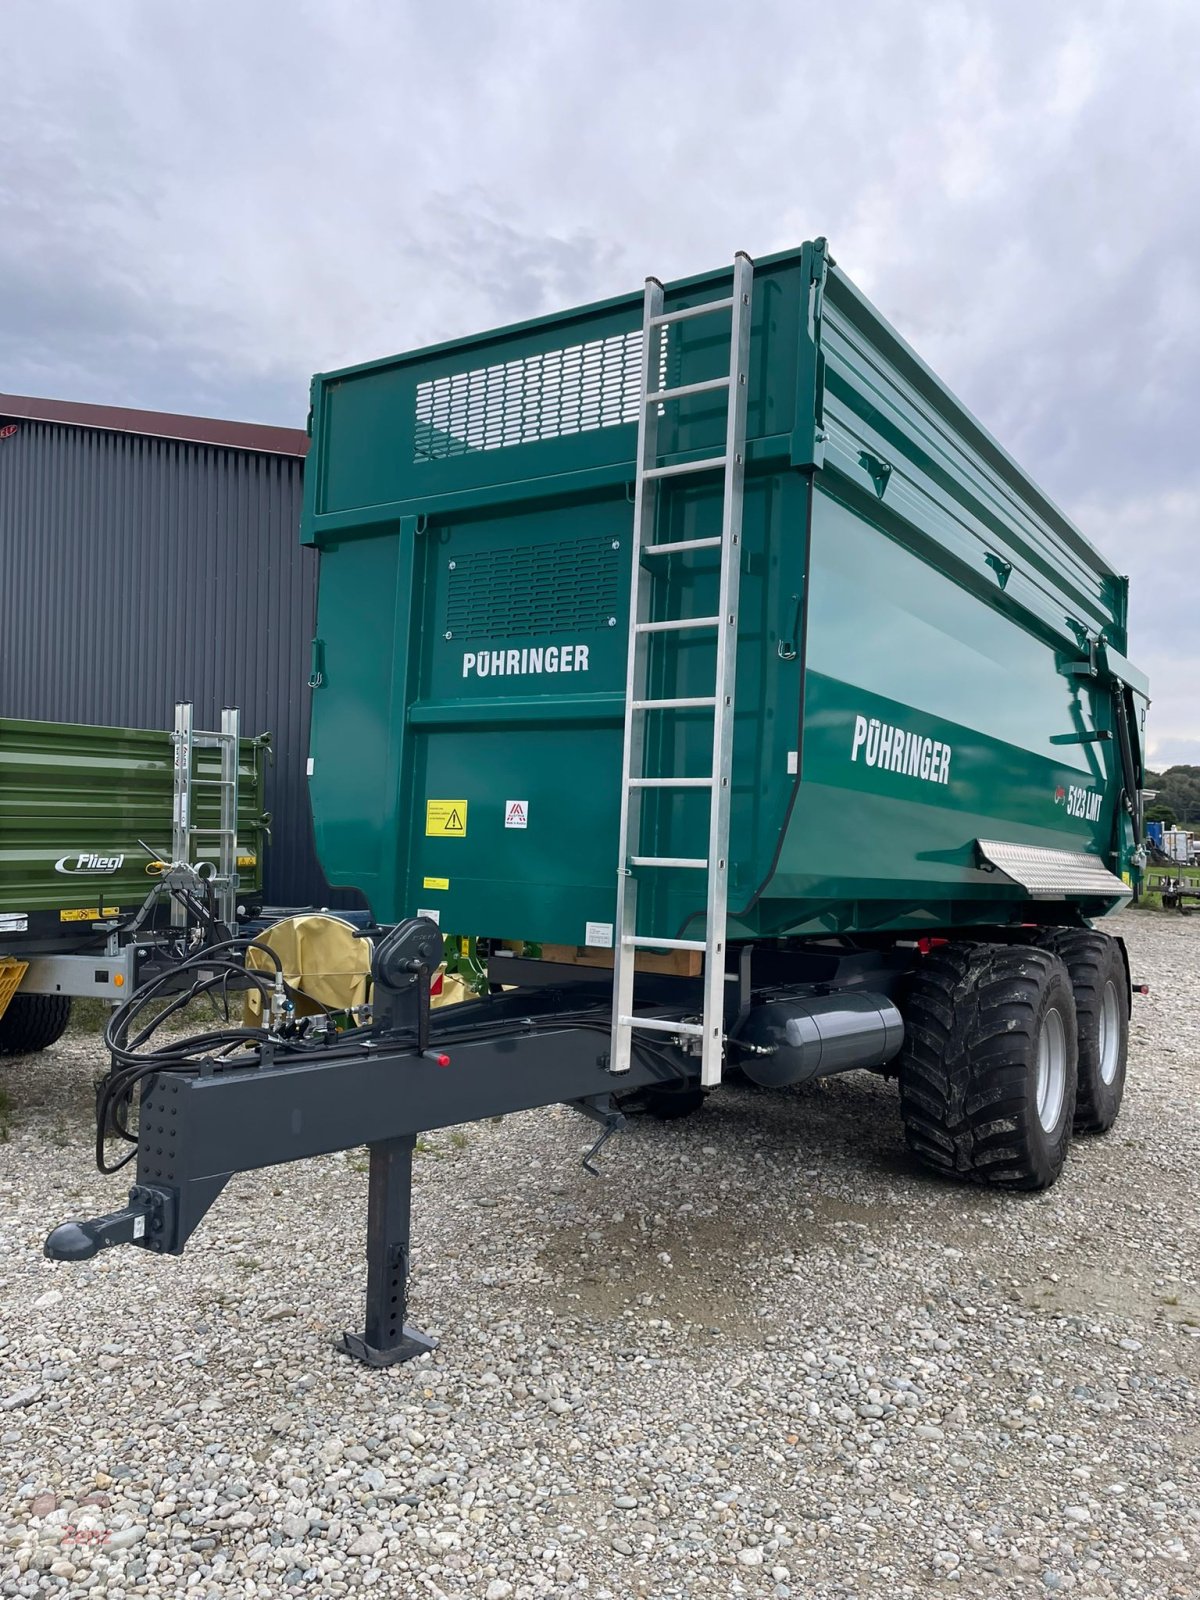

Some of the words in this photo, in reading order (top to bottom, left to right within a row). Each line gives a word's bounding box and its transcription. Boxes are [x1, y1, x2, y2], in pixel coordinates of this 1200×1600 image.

[462, 645, 589, 678] PÜHRINGER
[850, 714, 952, 785] PÜHRINGER
[1066, 785, 1086, 819] 5123
[1085, 791, 1103, 823] LMT
[76, 853, 125, 872] Fliegl
